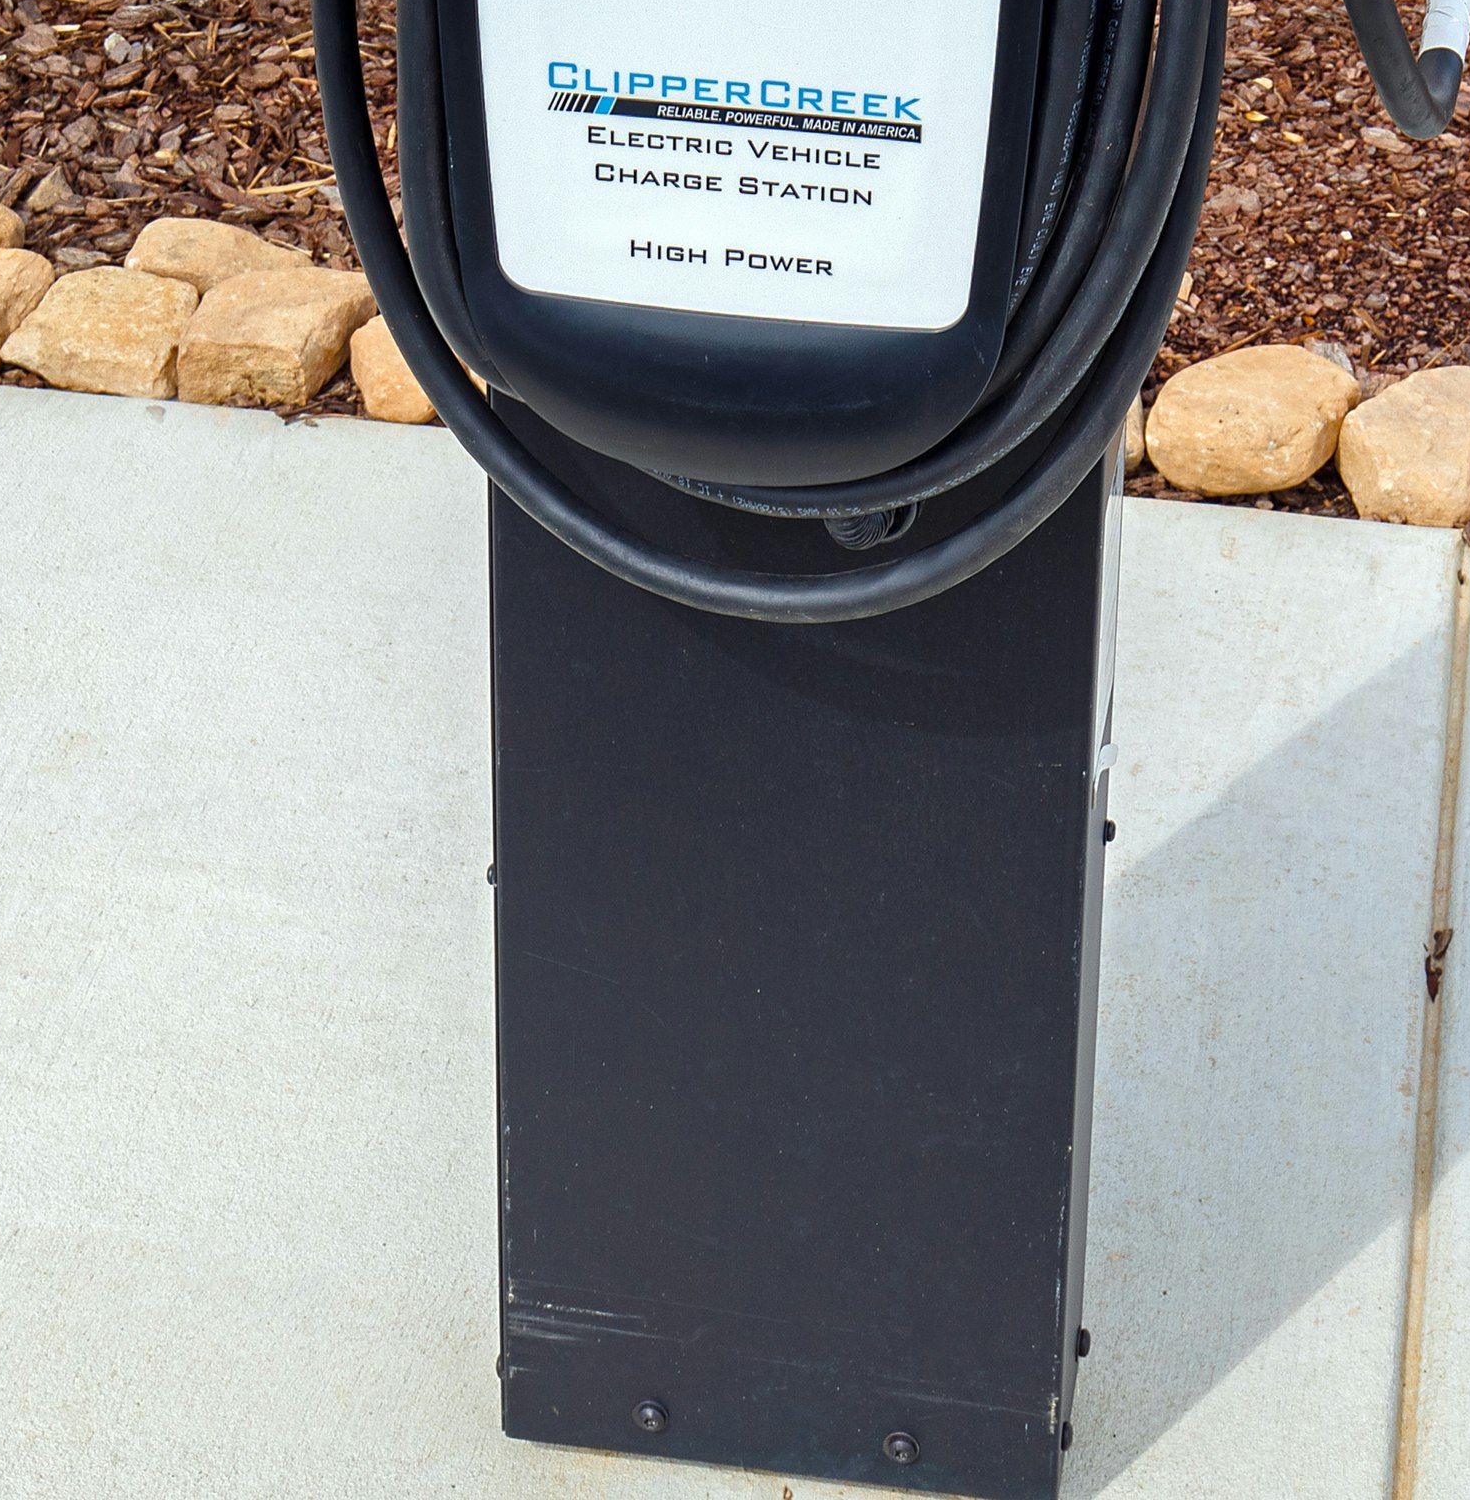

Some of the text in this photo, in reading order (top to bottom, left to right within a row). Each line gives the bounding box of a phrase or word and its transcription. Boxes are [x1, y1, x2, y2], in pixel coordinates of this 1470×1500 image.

[548, 61, 922, 121] CLIPPERCREEK
[656, 103, 920, 140] RELIABLE. POWERFUL. MADE IN AMERICA.
[587, 125, 881, 170] ELECTRIC VEHICLE
[595, 163, 872, 206] CHARGE STATION
[630, 239, 834, 276] HIGH POWER
